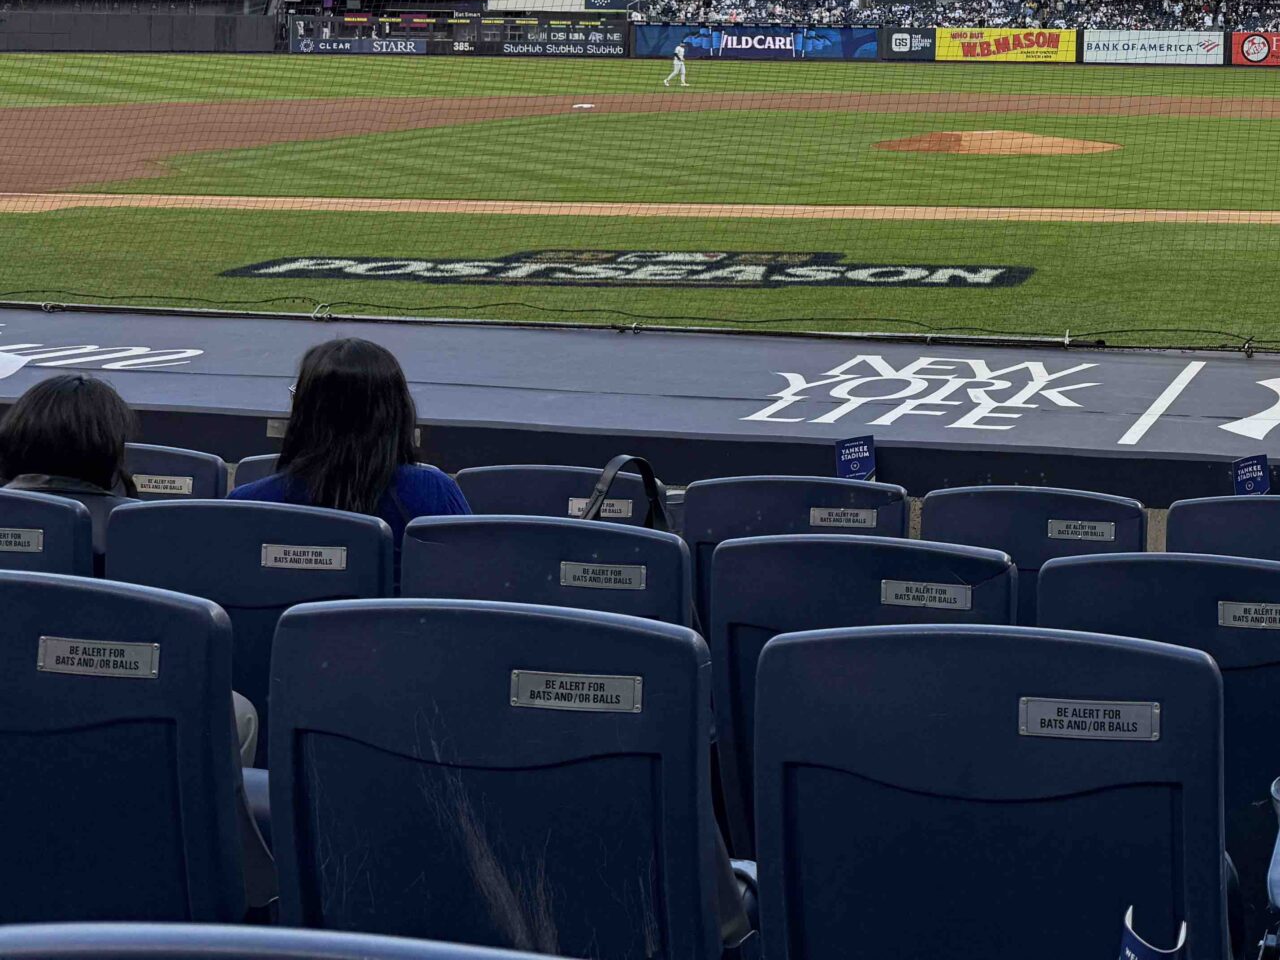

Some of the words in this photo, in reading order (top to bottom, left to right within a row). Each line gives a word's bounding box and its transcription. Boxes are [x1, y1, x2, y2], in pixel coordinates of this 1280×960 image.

[951, 32, 968, 40] WHO
[319, 42, 350, 50] CLEAR
[373, 41, 416, 52] STARR
[453, 42, 469, 51] 385
[894, 38, 908, 47] GS
[1087, 42, 1119, 51] BANK
[1122, 43, 1136, 51] OF
[1140, 43, 1193, 52] AMERICA
[503, 44, 543, 54] StubHub
[546, 44, 584, 54] StubHub
[587, 44, 624, 55] StubHub
[258, 257, 1006, 287] POSTSEASON
[820, 354, 1101, 382] NEW
[767, 371, 1104, 408] YORK
[738, 399, 1022, 430] LIFE
[841, 445, 868, 455] YANKEE
[841, 451, 869, 460] STADIUM
[1238, 465, 1261, 474] YANKEE
[1238, 471, 1263, 481] STADIUM
[591, 568, 608, 576] ALERT
[589, 576, 612, 584] AND/OR
[938, 596, 957, 604] BALLS
[1254, 608, 1273, 616] ALERT
[1251, 616, 1277, 624] AND/OR
[70, 646, 79, 655] BE
[82, 647, 106, 657] ALERT
[110, 648, 125, 658] FOR
[56, 656, 75, 666] BATS
[77, 657, 110, 669] AND/OR
[112, 660, 139, 670] BALLS
[545, 680, 556, 689] BE
[558, 681, 586, 691] ALERT
[588, 682, 605, 692] FOR
[530, 690, 551, 701] BATS
[554, 692, 590, 703] AND/OR
[593, 694, 621, 704] BALLS
[1057, 707, 1068, 717] BE
[1071, 708, 1100, 719] ALERT
[1103, 709, 1120, 720] FOR
[1040, 718, 1064, 729] BATS
[1067, 720, 1105, 731] AND/OR
[1108, 721, 1138, 732] BALLS
